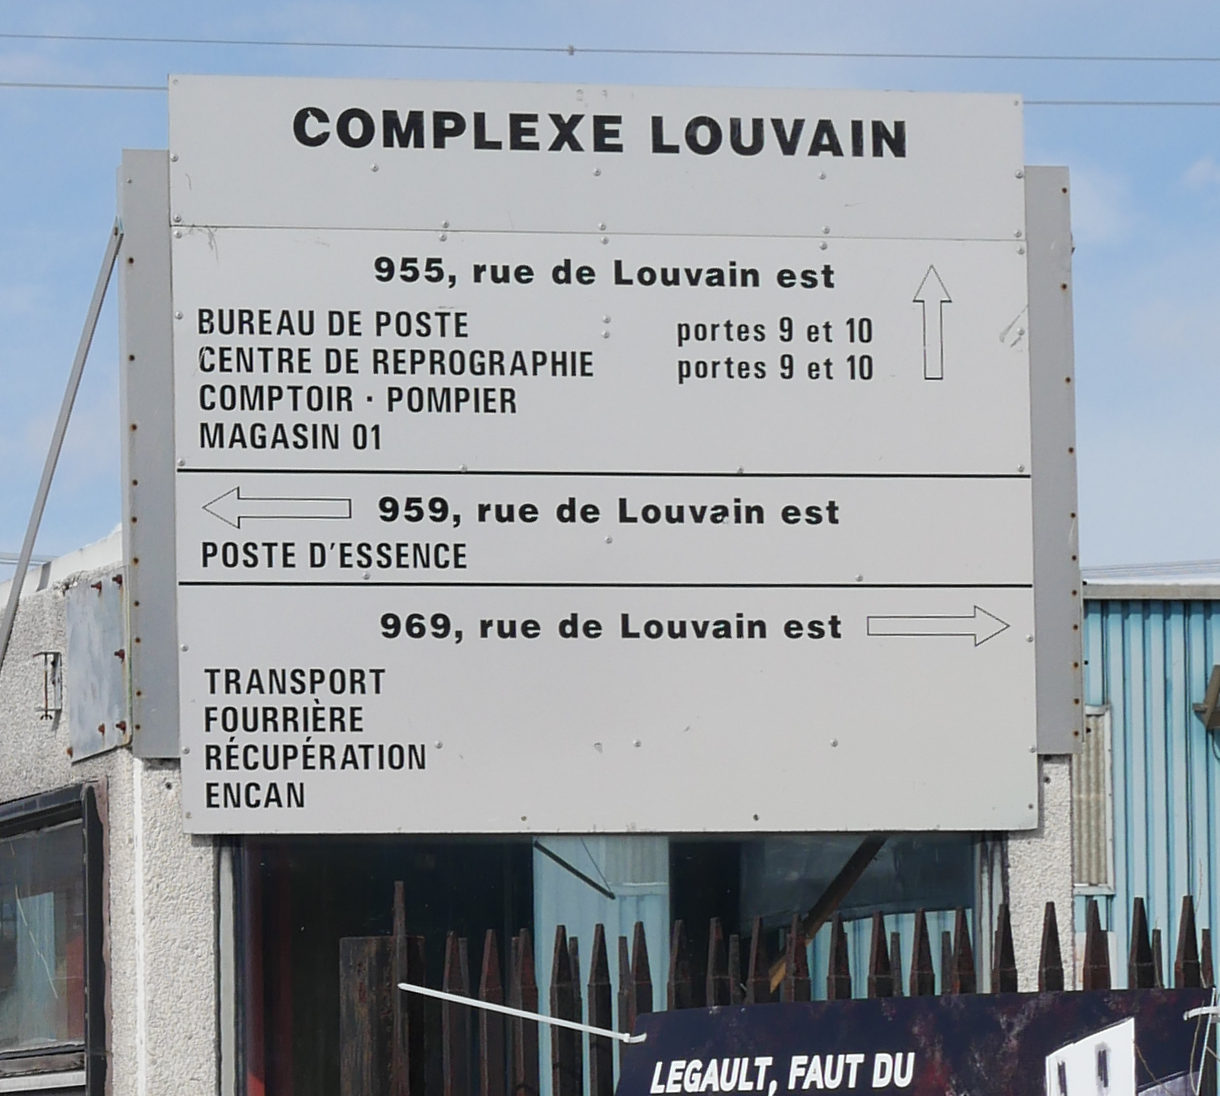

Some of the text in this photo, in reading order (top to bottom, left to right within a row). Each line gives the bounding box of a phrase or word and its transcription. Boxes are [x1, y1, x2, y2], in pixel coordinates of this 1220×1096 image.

[293, 107, 905, 157] COMPLEXE LOUVAIN
[375, 257, 834, 288] 955, rue de Louvain est
[199, 309, 468, 337] BUREAU DE POSTE
[678, 317, 872, 347] portes 9 et 10
[199, 347, 593, 376] CENTRE DE REPROGRAPHIE
[679, 354, 872, 384] portes 9 et 10
[200, 385, 352, 411] COMPTOIR
[388, 387, 516, 413] POMPIER
[201, 423, 380, 449] MAGASIN 01
[379, 497, 838, 528] 959, rue de Louvain est
[203, 542, 466, 568] POSTE D'ESSENCE
[381, 613, 841, 644] 969, rue de Louvain est
[204, 669, 385, 694] TRANSPORT
[205, 699, 363, 732] FOURRIÈRE
[206, 737, 425, 770] RÉCUPÉRATION
[206, 783, 304, 808] ENCAN
[788, 1054, 864, 1089] FAUT
[872, 1053, 915, 1087] DU
